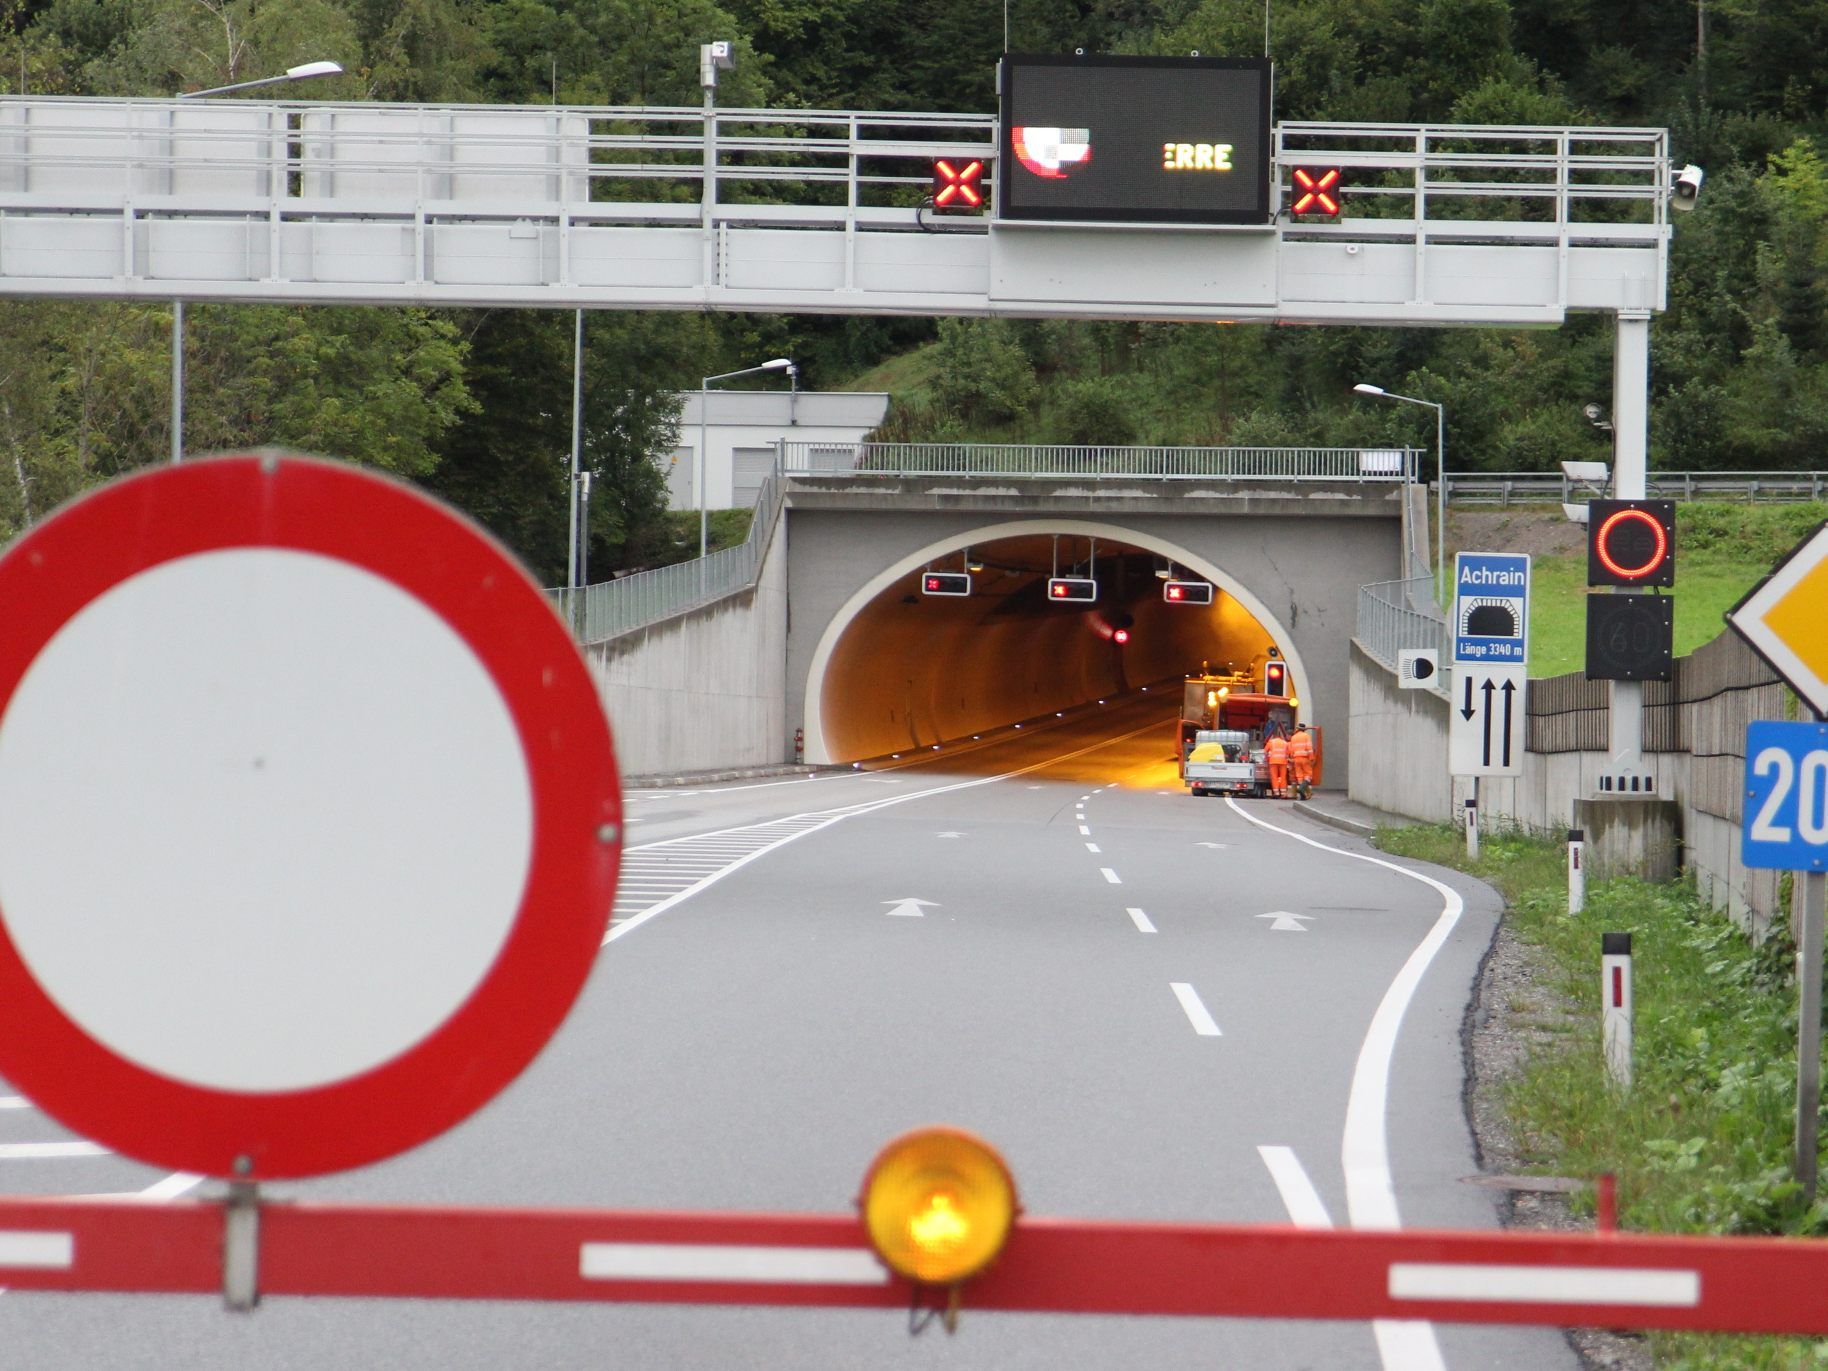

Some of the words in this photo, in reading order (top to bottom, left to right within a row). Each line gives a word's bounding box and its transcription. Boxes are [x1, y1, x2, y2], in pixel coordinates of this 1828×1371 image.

[1460, 565, 1525, 585] Achrain
[1460, 642, 1487, 657] Länge
[1489, 643, 1511, 655] 3340
[1513, 646, 1522, 656] m
[1750, 747, 1828, 845] 20
